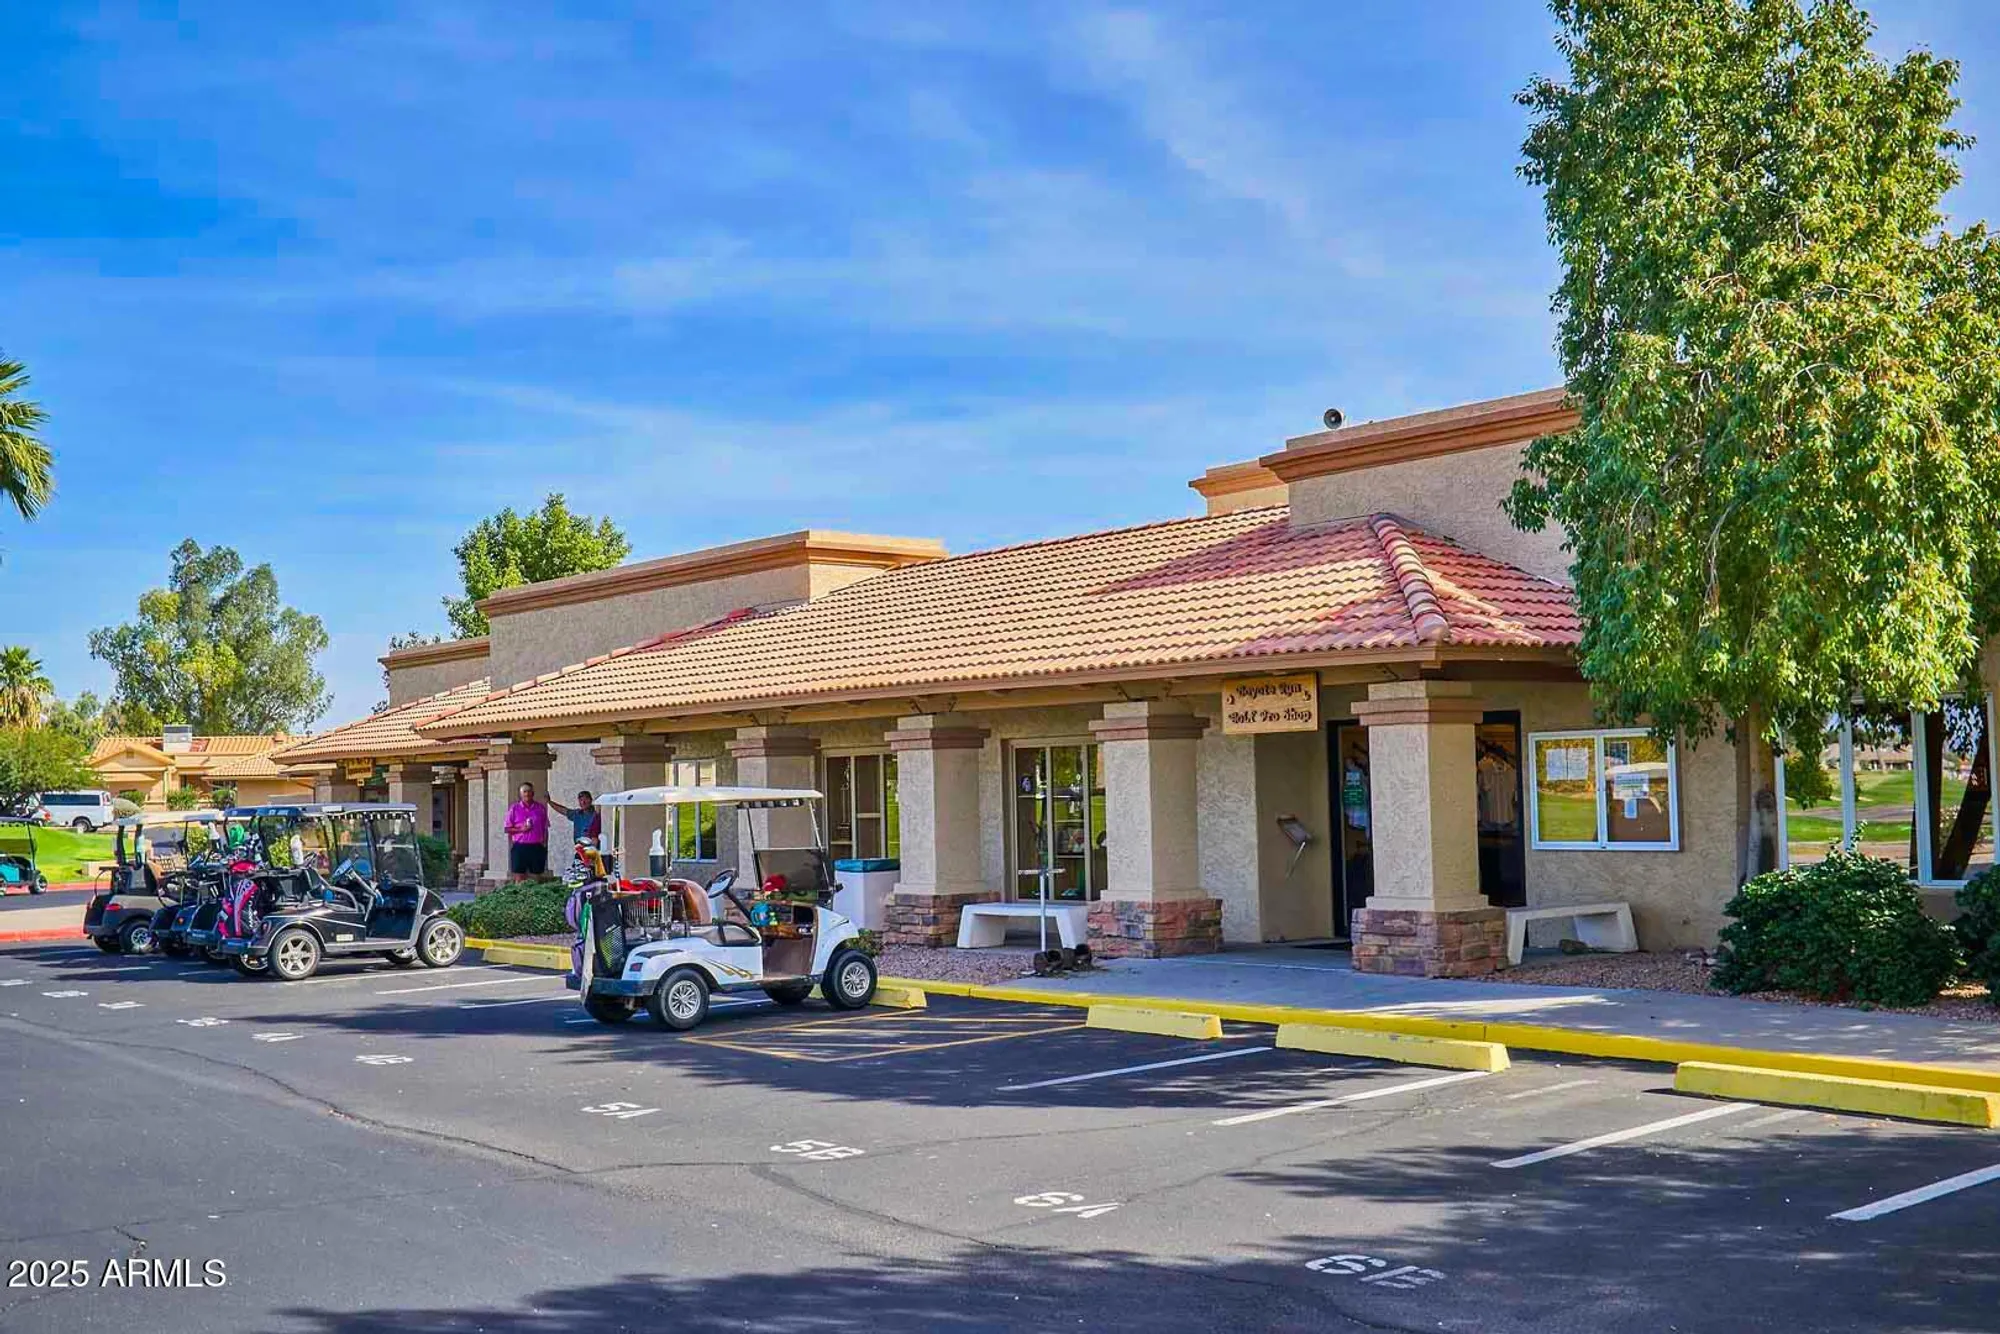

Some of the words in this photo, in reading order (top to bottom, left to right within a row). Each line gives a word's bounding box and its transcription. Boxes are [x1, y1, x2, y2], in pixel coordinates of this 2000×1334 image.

[1279, 683, 1302, 697] Run
[1228, 710, 1257, 723] Golf
[1260, 709, 1280, 722] Pro
[1283, 707, 1312, 722] Shop
